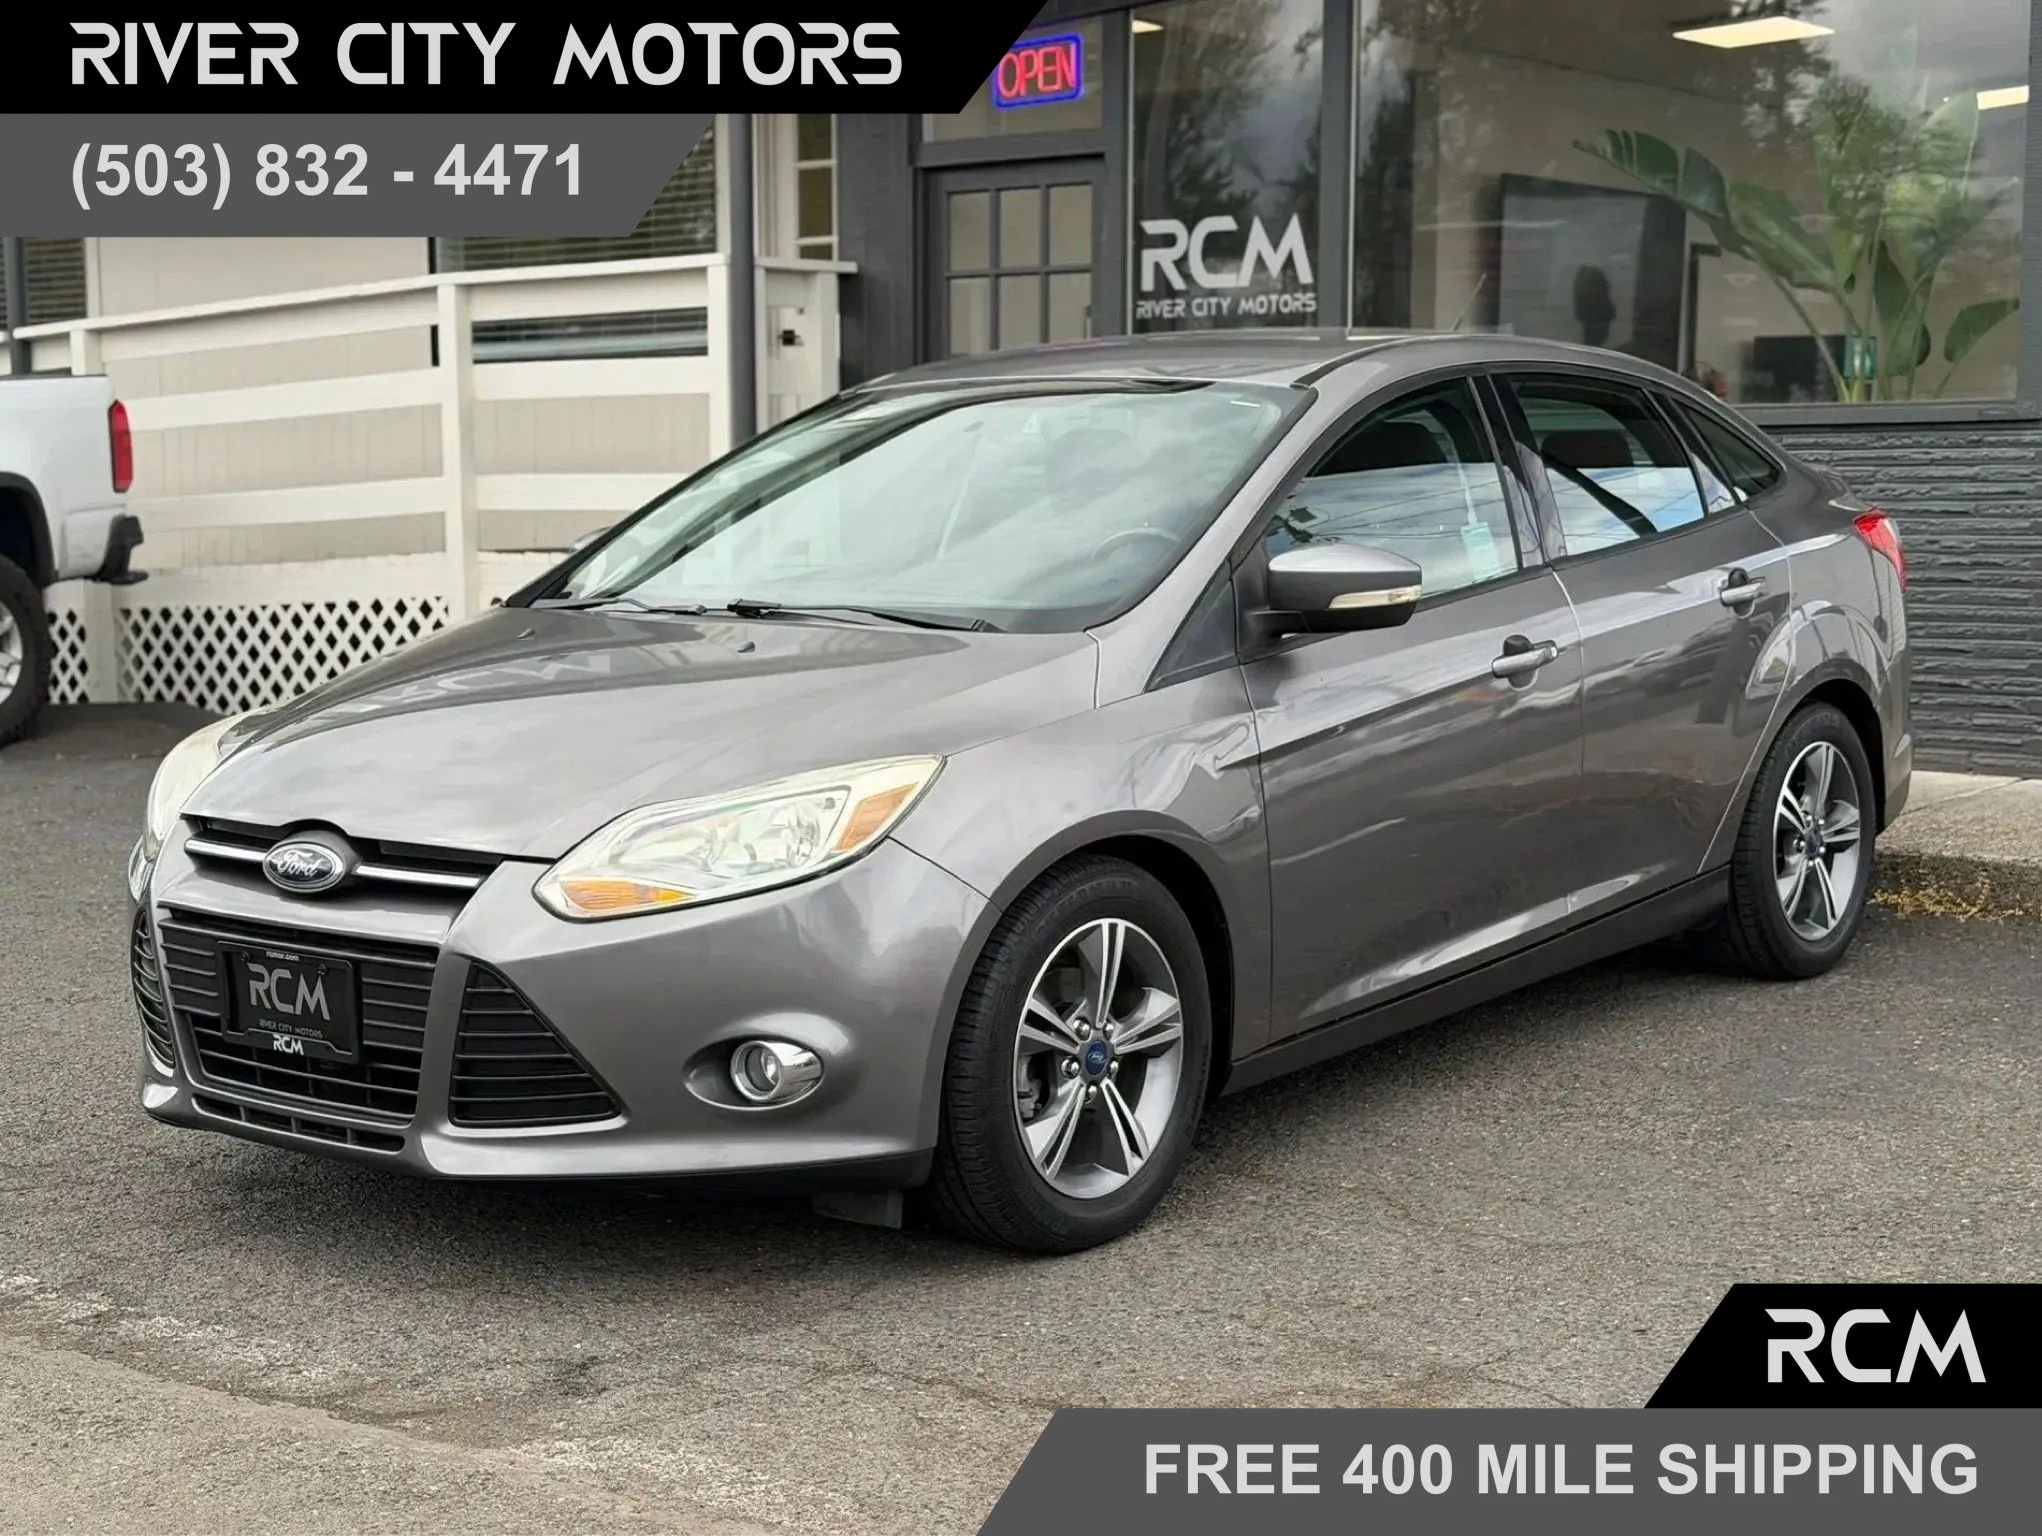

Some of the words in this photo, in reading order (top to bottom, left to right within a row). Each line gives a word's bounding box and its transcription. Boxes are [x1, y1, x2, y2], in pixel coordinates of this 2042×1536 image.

[998, 43, 1076, 98] OPEN
[1139, 212, 1314, 292] RCM
[1136, 300, 1186, 319] RIVER
[1191, 297, 1232, 317] CITY
[1237, 292, 1317, 315] MOTORS
[277, 849, 322, 877] Ford
[247, 962, 330, 1021] RCM
[272, 1033, 304, 1056] RCM
